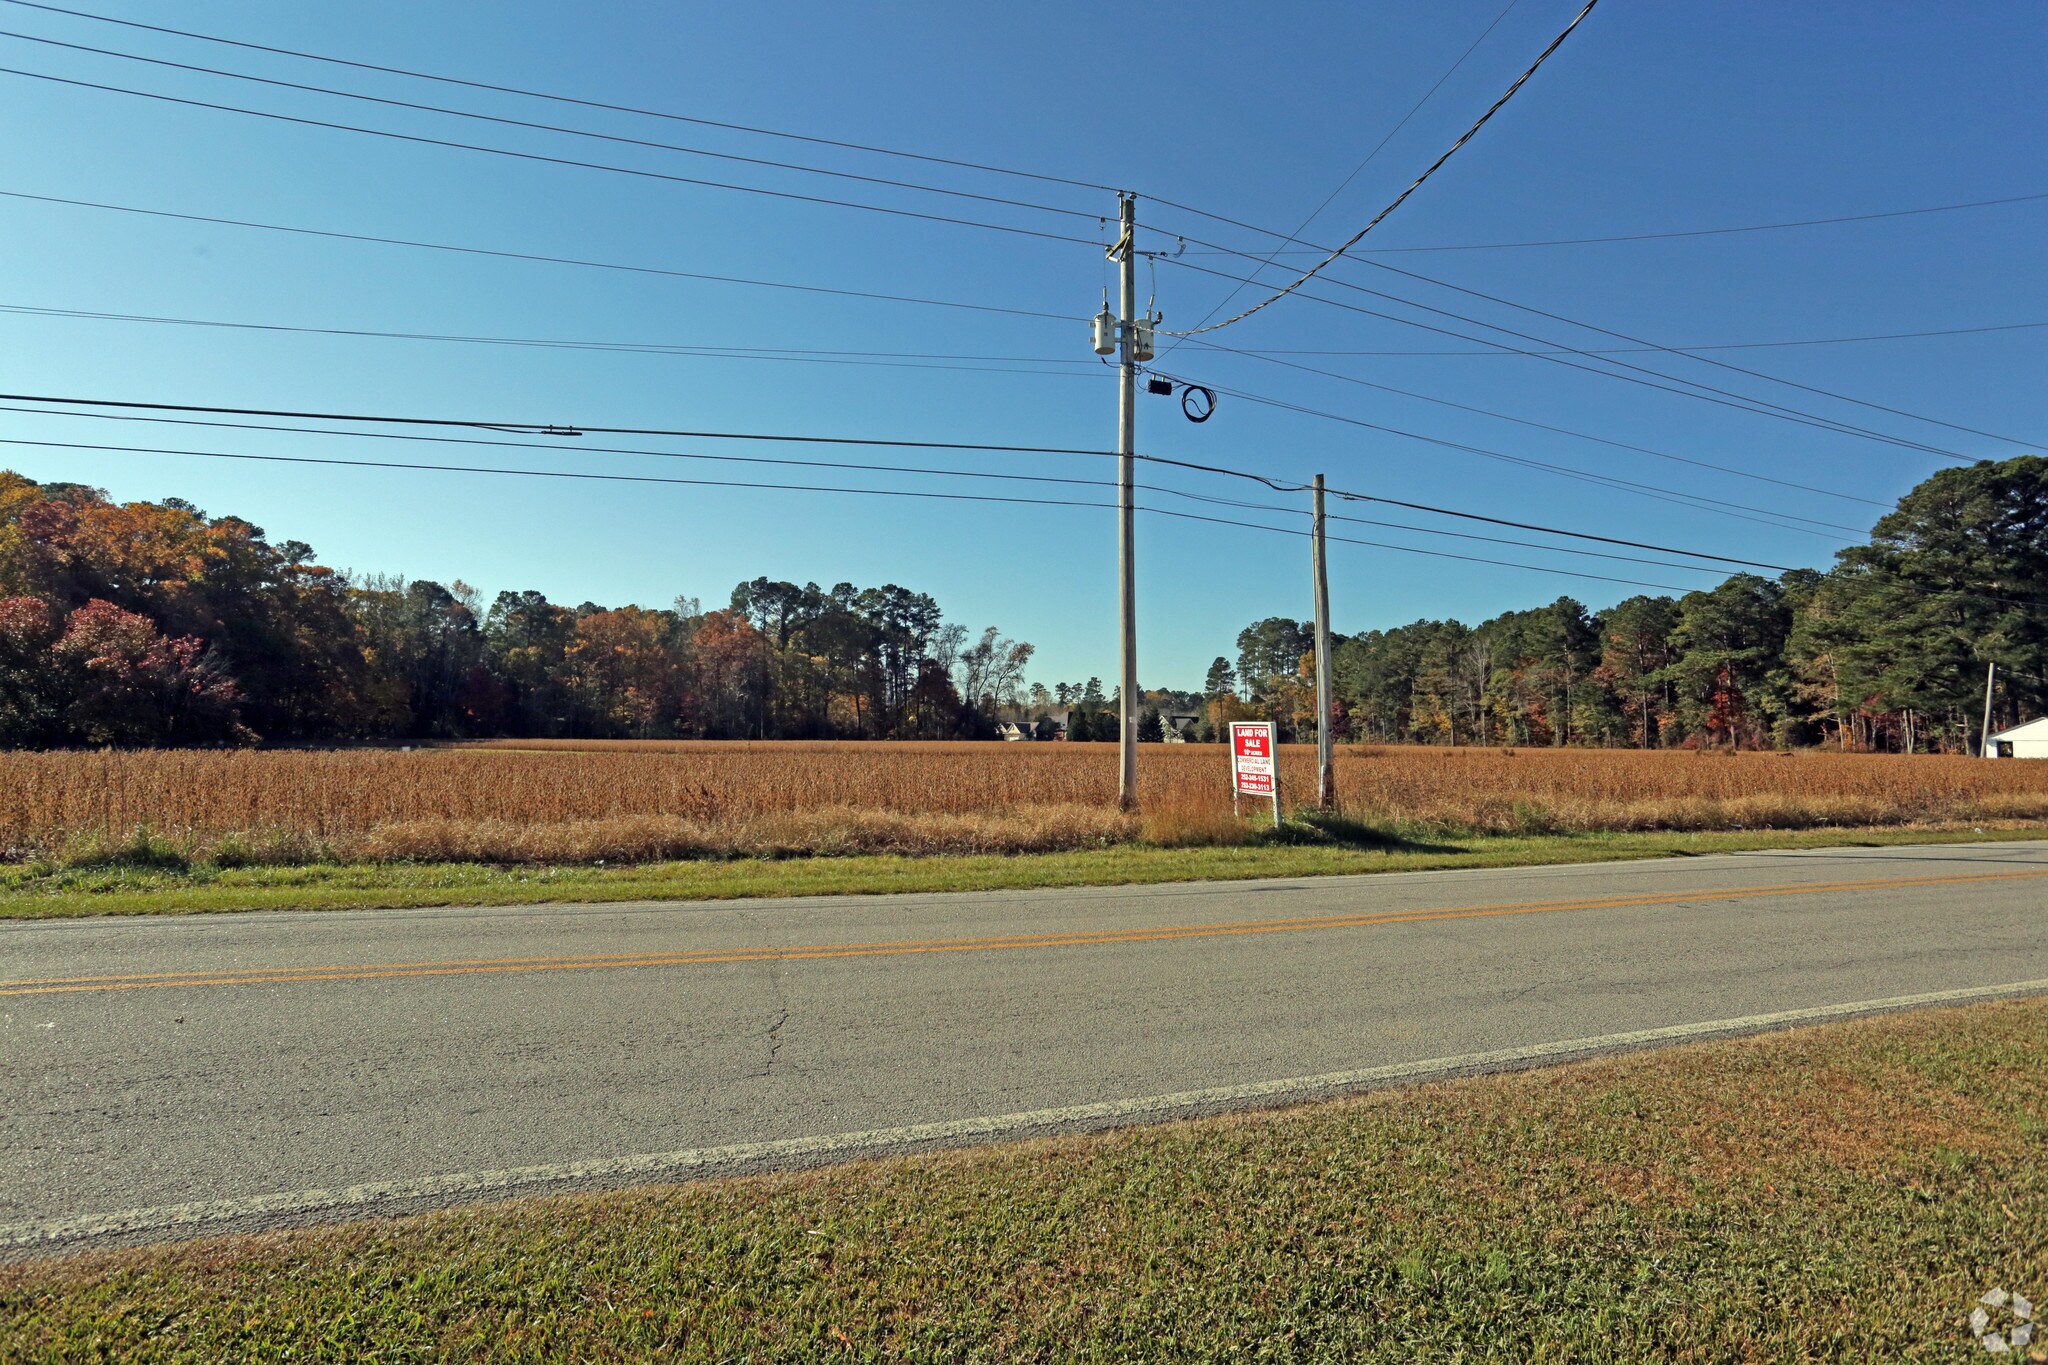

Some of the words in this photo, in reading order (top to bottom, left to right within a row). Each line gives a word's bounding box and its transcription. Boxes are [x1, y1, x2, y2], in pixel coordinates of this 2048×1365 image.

[1237, 728, 1253, 737] LAND
[1254, 729, 1268, 737] FOR
[1245, 739, 1260, 747] SALE
